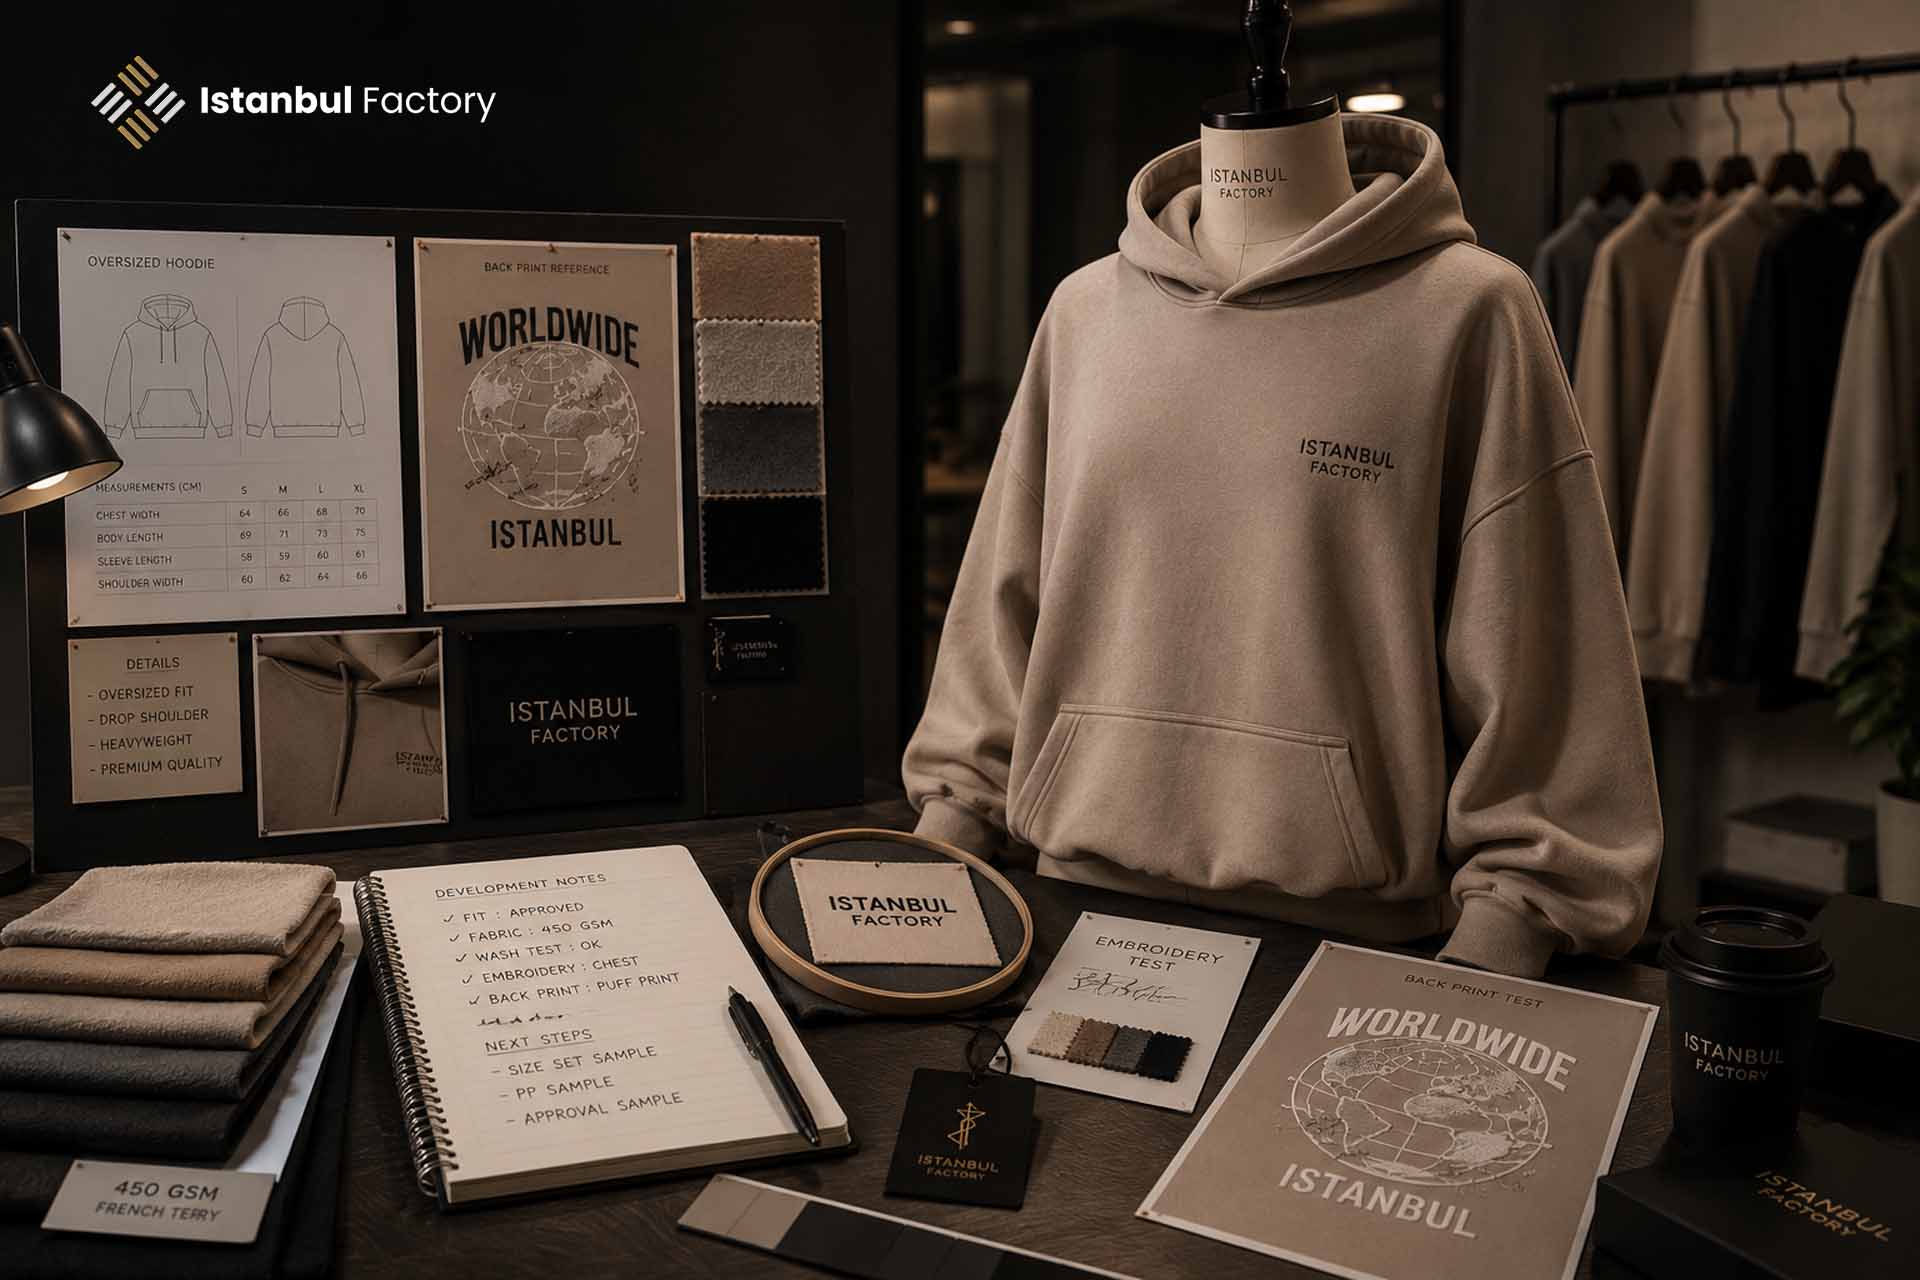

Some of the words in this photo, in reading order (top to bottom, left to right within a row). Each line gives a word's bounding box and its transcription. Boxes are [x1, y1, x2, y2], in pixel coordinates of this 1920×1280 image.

[1211, 168, 1288, 183] ISTANBUL
[1220, 187, 1273, 198] FACTORY
[88, 256, 160, 268] OVERSIZED
[166, 258, 214, 269] HOODIE
[484, 262, 512, 272] BACK
[517, 264, 546, 272] PRINT
[551, 264, 608, 274] REFERENCE
[459, 306, 639, 368] WORLDWIDE
[1300, 437, 1395, 469] ISTANBUL
[1311, 461, 1381, 483] FACTORY
[96, 482, 175, 492] MEASUREMENTS
[241, 486, 247, 495] S
[280, 485, 287, 494] M
[319, 485, 324, 493] L
[354, 484, 364, 493] XL
[96, 511, 125, 520] CHEST
[240, 509, 250, 518] 64
[278, 508, 289, 516] 66
[317, 507, 328, 516] 68
[97, 534, 123, 543] BODY
[127, 533, 163, 542] LENGTH
[240, 531, 252, 539] 69
[280, 530, 288, 538] 71
[318, 529, 328, 537] 73
[355, 528, 366, 536] 75
[490, 518, 622, 548] ISTANBUL
[98, 557, 133, 566] SLEEVE
[136, 556, 172, 566] LENGTH
[241, 552, 252, 561] 58
[280, 552, 290, 560] 59
[318, 551, 328, 559] 60
[356, 550, 365, 558] 61
[98, 578, 149, 589] SHOULDER
[152, 577, 183, 588] WIDTH
[241, 575, 253, 584] 60
[127, 657, 180, 670] DETAILS
[98, 686, 170, 701] OVERSIZED
[176, 685, 194, 697] FIT
[99, 712, 135, 726] DROP
[140, 709, 209, 724] SHOULDER
[510, 696, 638, 723] ISTANBUL
[100, 734, 193, 751] HEAVYWEIGHT
[531, 724, 620, 744] FACTORY
[101, 760, 162, 776] PREMIUM
[168, 756, 223, 773] QUALITY
[435, 879, 548, 898] DEVELOPMENT
[556, 874, 607, 886] NOTES
[464, 911, 486, 922] FIT
[510, 902, 584, 919] APPROVED
[829, 896, 957, 913] ISTANBUL
[852, 914, 943, 927] FACTORY
[469, 928, 522, 943] FABRIC
[542, 924, 572, 934] 450
[580, 920, 614, 930] GSM
[475, 949, 520, 962] WASH
[528, 944, 562, 957] TEST
[580, 940, 601, 950] OK
[1095, 936, 1225, 964] EMBROIDERY
[483, 964, 576, 984] EMBROIDERY
[593, 956, 639, 970] CHEST
[1129, 956, 1176, 972] TEST
[489, 991, 529, 1005] BACK
[538, 985, 580, 999] PRINT
[597, 979, 633, 992] PUFF
[639, 972, 681, 986] PRINT
[1404, 974, 1448, 990] BACK
[1452, 983, 1501, 1000] PRINT
[1505, 994, 1544, 1009] TEST
[485, 1037, 529, 1052] NEXT
[540, 1029, 593, 1045] STEPS
[1327, 1007, 1577, 1092] WORLDWIDE
[1684, 1031, 1784, 1065] ISTANBUL
[508, 1061, 544, 1076] SIZE
[554, 1056, 583, 1070] SET
[593, 1046, 657, 1064] SAMPLE
[1696, 1058, 1769, 1081] FACTORY
[516, 1087, 536, 1100] PP
[547, 1076, 615, 1095] SAMPLE
[525, 1104, 609, 1126] APPROVAL
[617, 1092, 683, 1112] SAMPLE
[918, 1154, 999, 1173] ISTANBUL
[926, 1168, 987, 1181] FACTORY
[114, 1181, 160, 1197] 450
[168, 1184, 219, 1201] GSM
[1279, 1163, 1479, 1239] ISTANBUL
[95, 1201, 164, 1218] FRENCH
[1755, 1170, 1892, 1242] ISTANBUL
[1758, 1186, 1856, 1237] FACTORY
